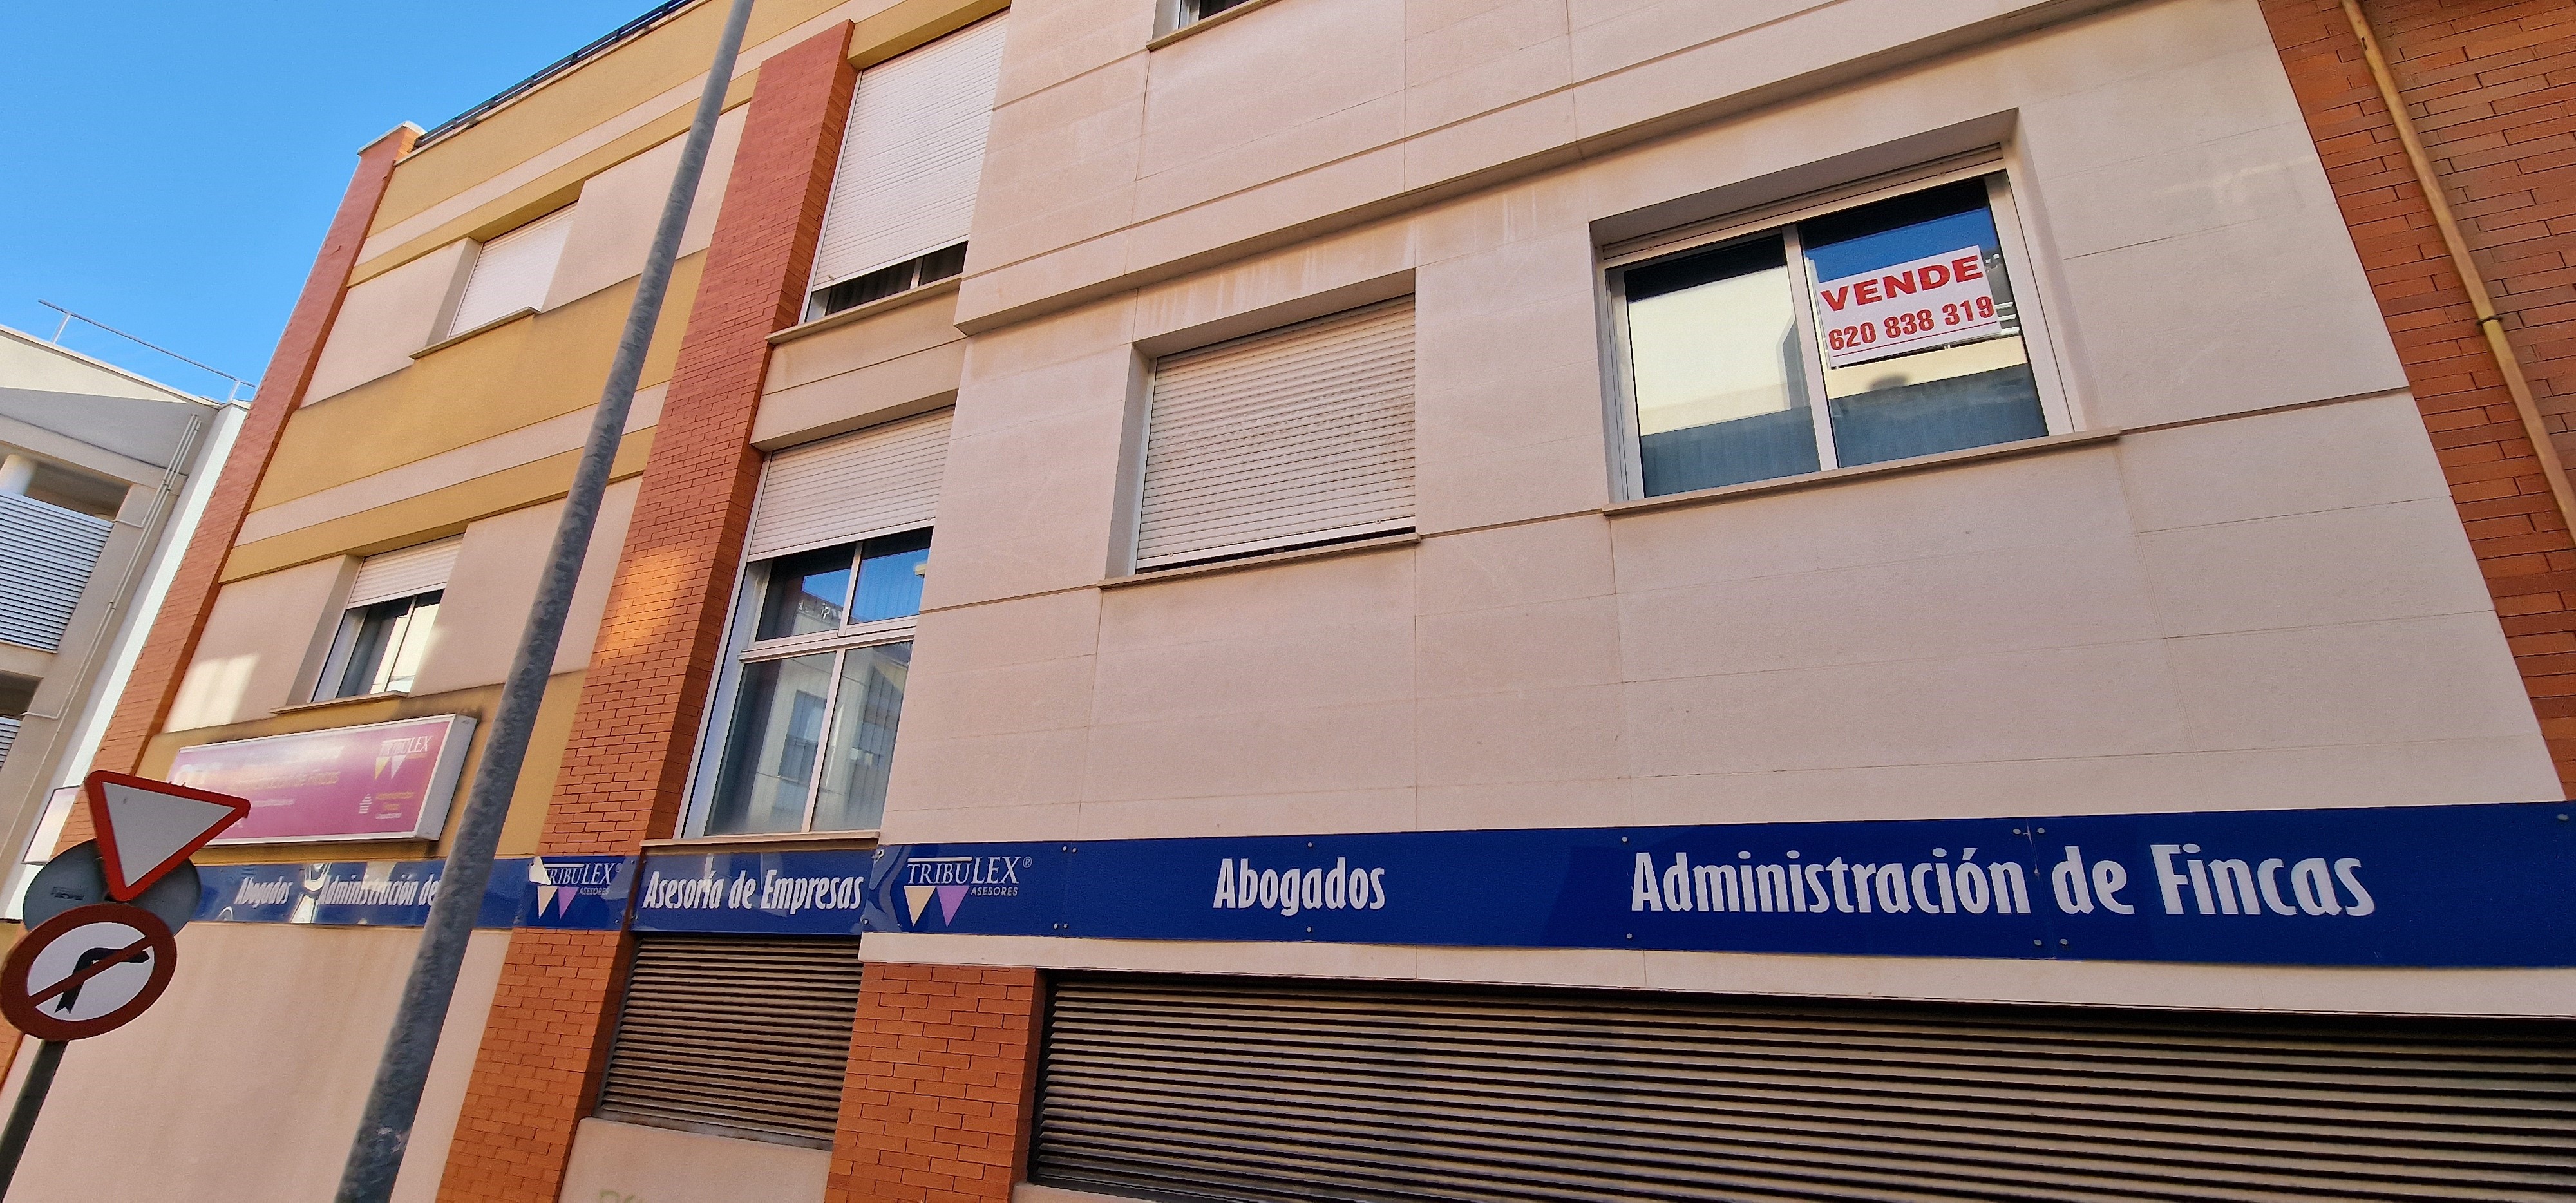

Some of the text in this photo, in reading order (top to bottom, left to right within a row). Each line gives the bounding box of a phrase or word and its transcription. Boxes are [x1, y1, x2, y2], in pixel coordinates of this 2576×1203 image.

[1821, 255, 1984, 311] VENDE
[1829, 296, 1994, 351] 620 838 319
[580, 887, 610, 895] ASESORES
[642, 869, 864, 915] Asesoría de Empresas
[971, 886, 1018, 896] ASESORES
[1213, 857, 1386, 916] Abogados
[1631, 843, 2375, 917] Administración de Fincas
